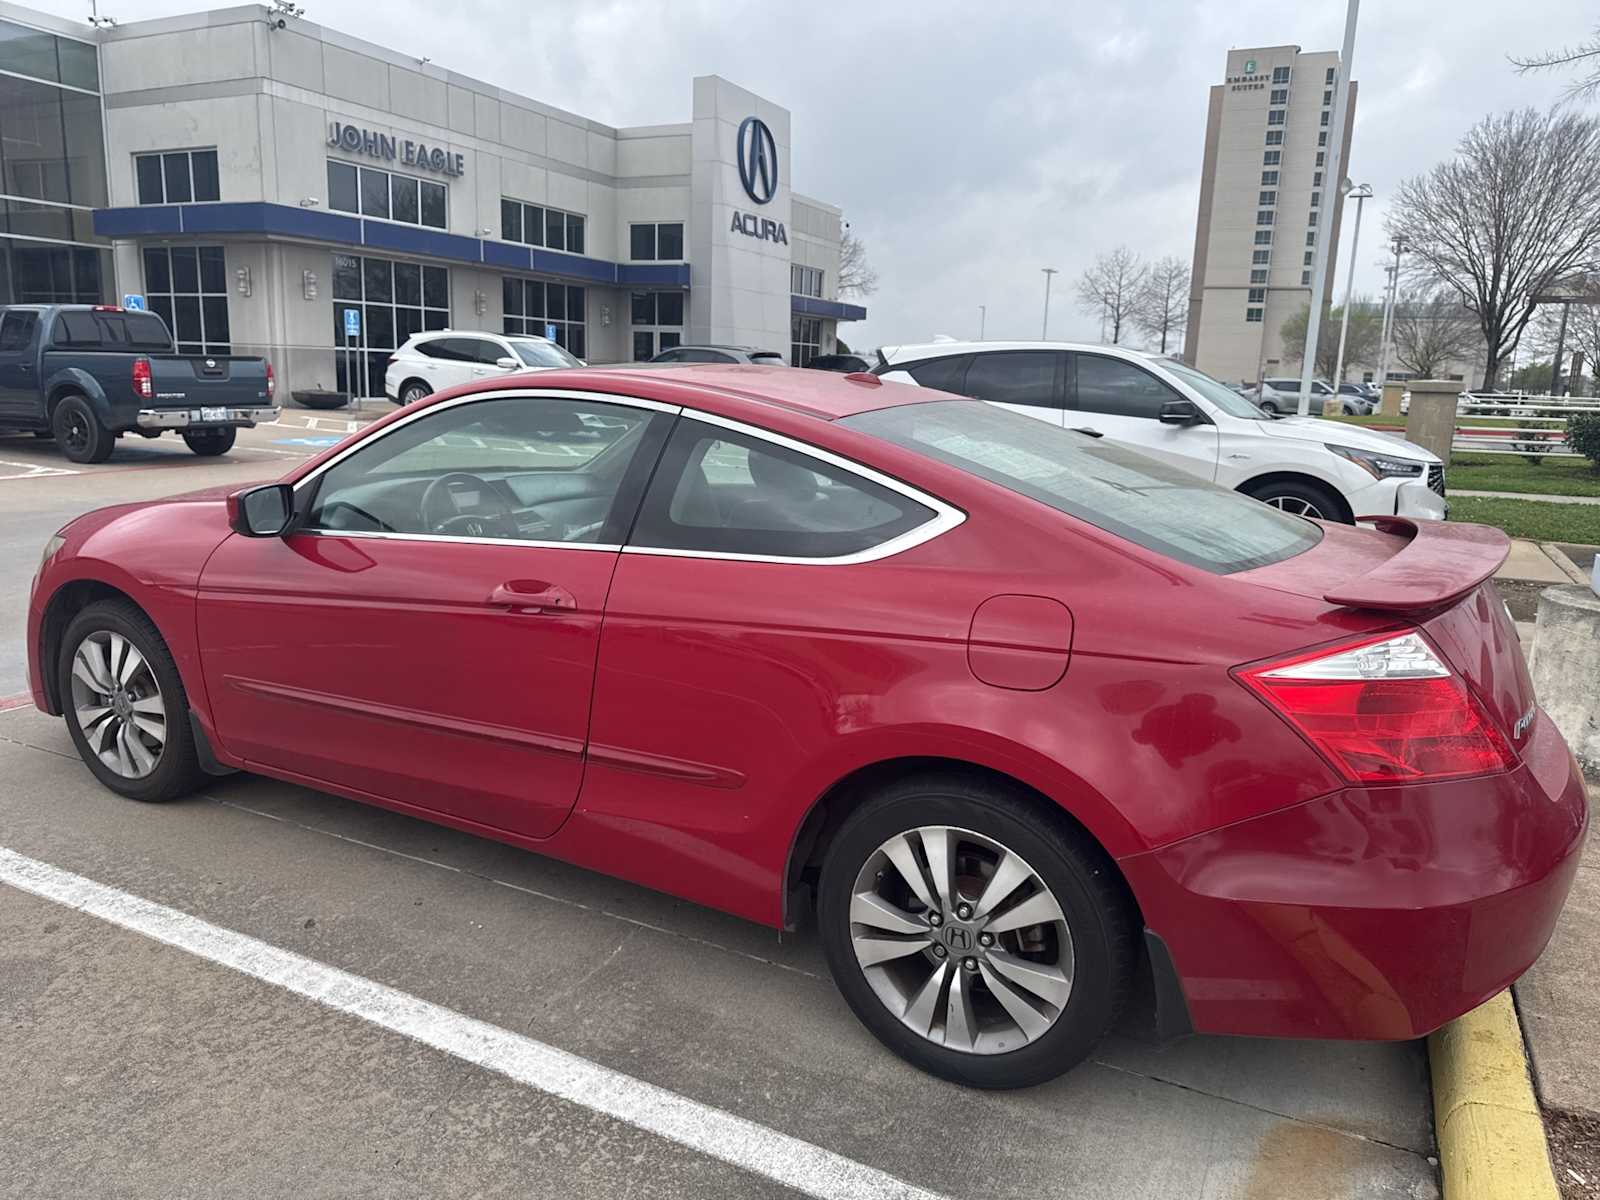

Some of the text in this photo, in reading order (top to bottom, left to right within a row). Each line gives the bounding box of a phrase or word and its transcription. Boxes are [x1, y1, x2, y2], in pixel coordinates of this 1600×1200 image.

[1231, 83, 1265, 91] SUITES
[329, 121, 465, 177] JOHN EAGLE
[730, 210, 788, 246] ACURA
